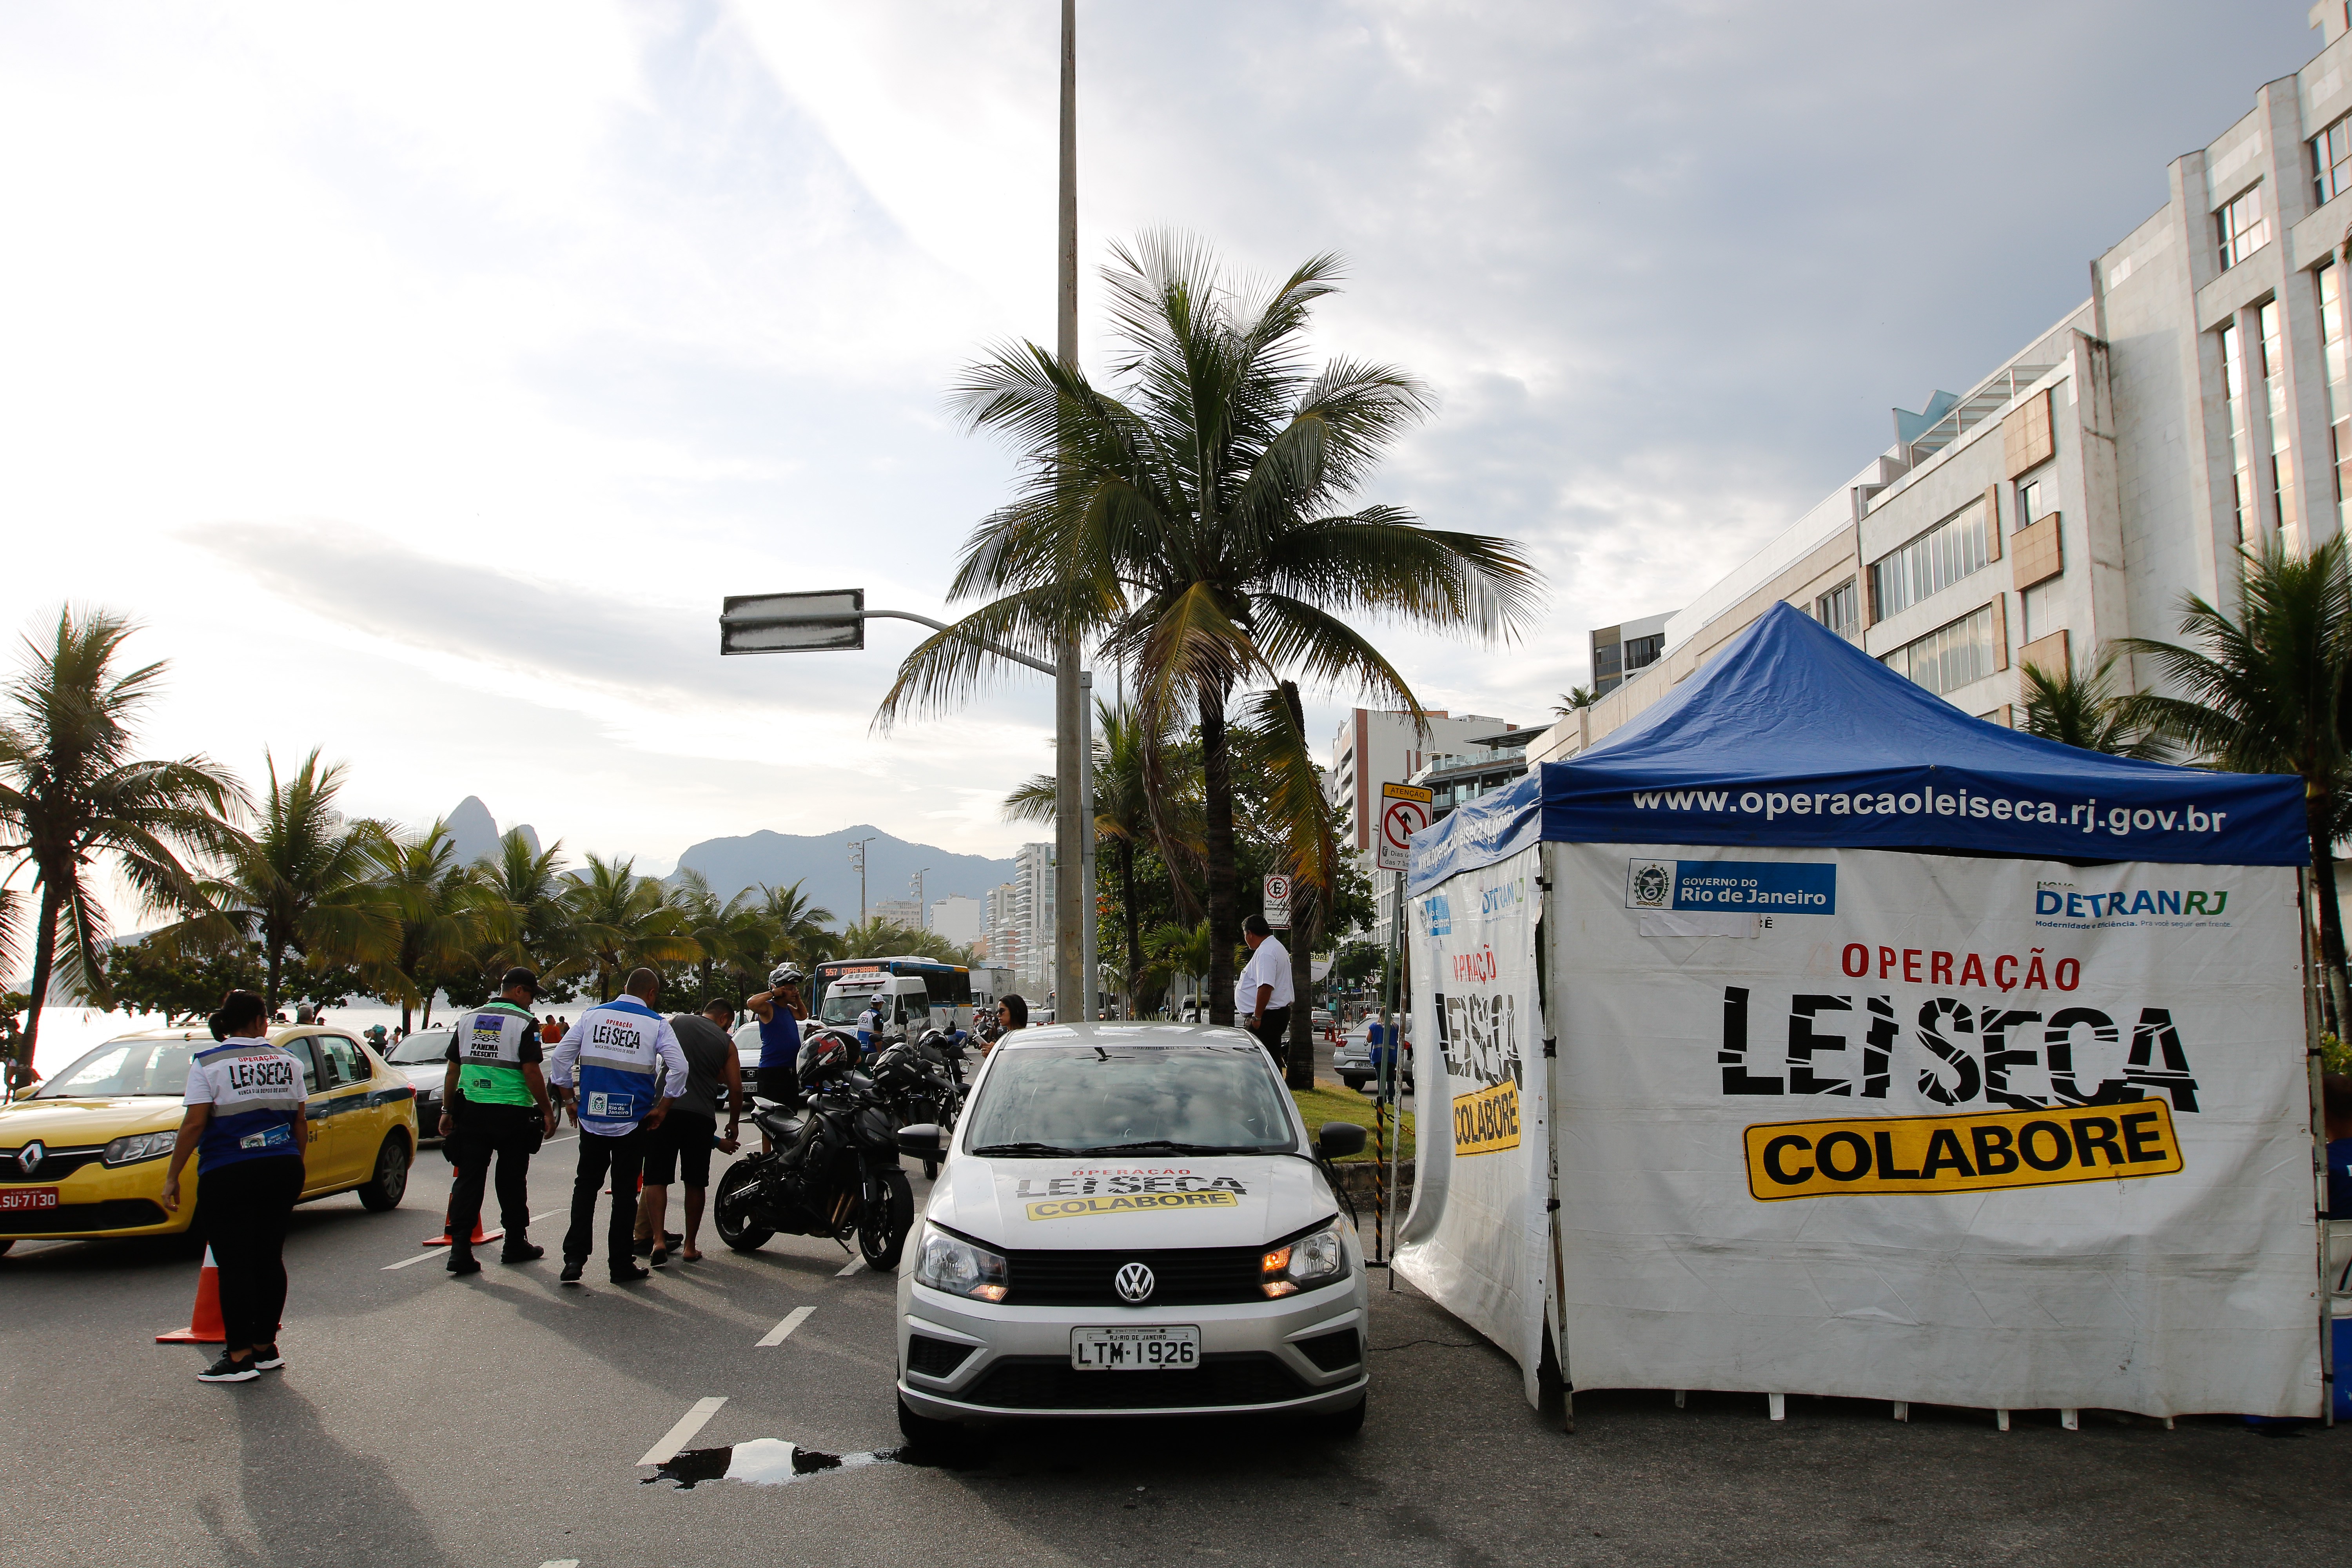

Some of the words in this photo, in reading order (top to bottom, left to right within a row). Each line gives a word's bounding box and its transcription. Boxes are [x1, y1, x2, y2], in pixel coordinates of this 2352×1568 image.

[1391, 788, 1424, 798] ATENÇÃO
[1633, 786, 2226, 835] www.operacaoleiseca.rj.gov.br
[1682, 878, 1737, 886] GOVERNO
[1681, 887, 1713, 902] Rio
[1718, 889, 1743, 902] de
[1747, 889, 1826, 905] Janeiro
[2035, 890, 2228, 917] DETRANRJ
[2036, 921, 2090, 929] Modernidade
[1841, 943, 2080, 992] OPERAÇÃO
[606, 1019, 633, 1028] OPERAÇÃO
[471, 1043, 498, 1051] IPANEMA
[1455, 1089, 1518, 1145] COLABORE
[754, 1118, 776, 1139] Kawasaki
[1762, 1111, 2167, 1185] COLABORE
[1035, 1194, 1230, 1216] COLABORE
